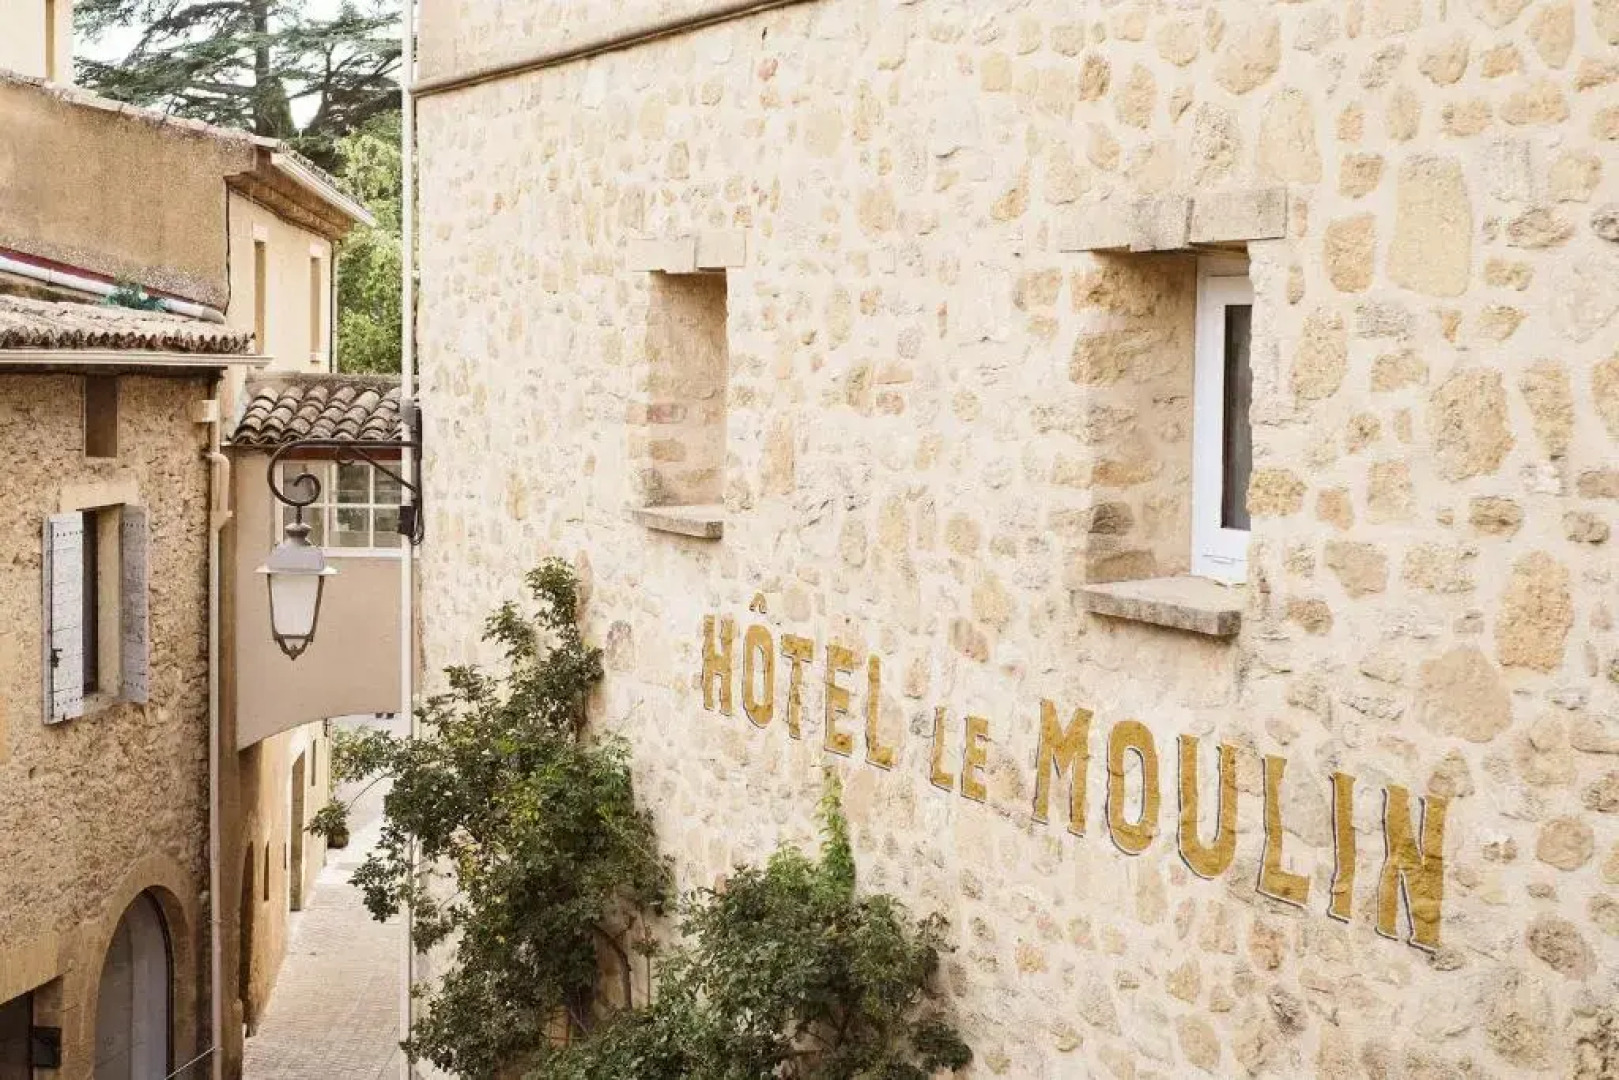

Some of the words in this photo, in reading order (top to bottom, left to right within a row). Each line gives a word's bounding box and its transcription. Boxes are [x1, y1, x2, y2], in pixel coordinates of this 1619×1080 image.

[702, 592, 895, 770] HÔTEL
[930, 706, 988, 803] LE
[1031, 699, 1448, 953] MOULIN
